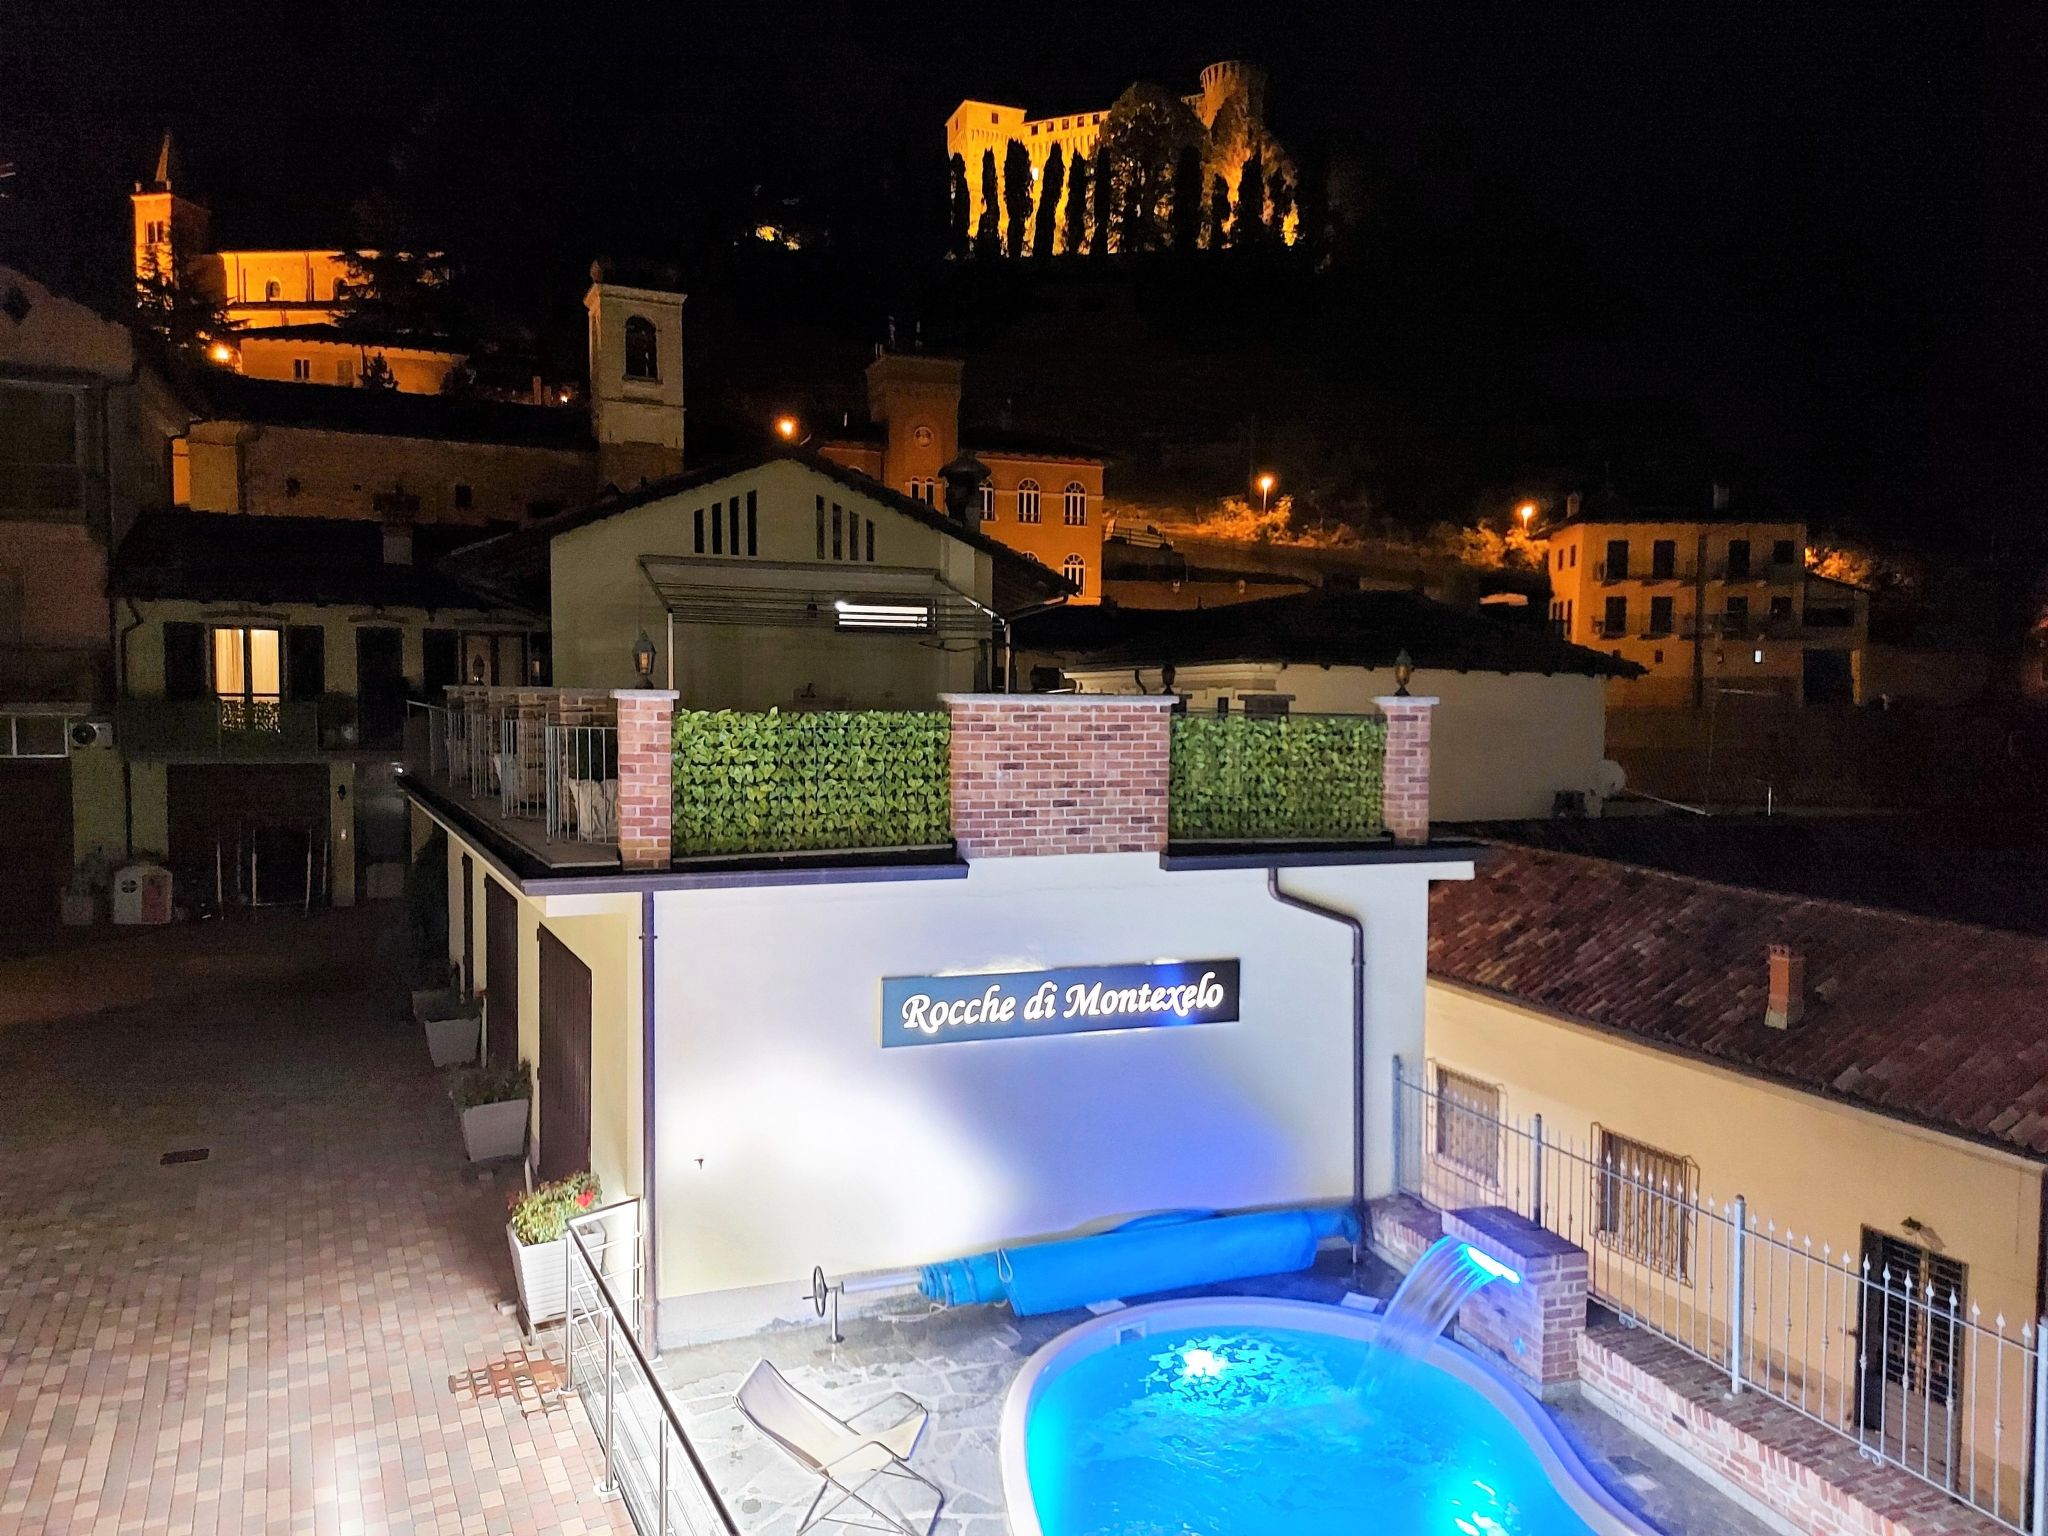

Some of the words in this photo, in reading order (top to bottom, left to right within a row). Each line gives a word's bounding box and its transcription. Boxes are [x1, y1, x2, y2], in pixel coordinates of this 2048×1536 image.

[901, 984, 1015, 1034] Rocche
[1023, 981, 1058, 1020] di
[1062, 971, 1226, 1018] Montexelo
